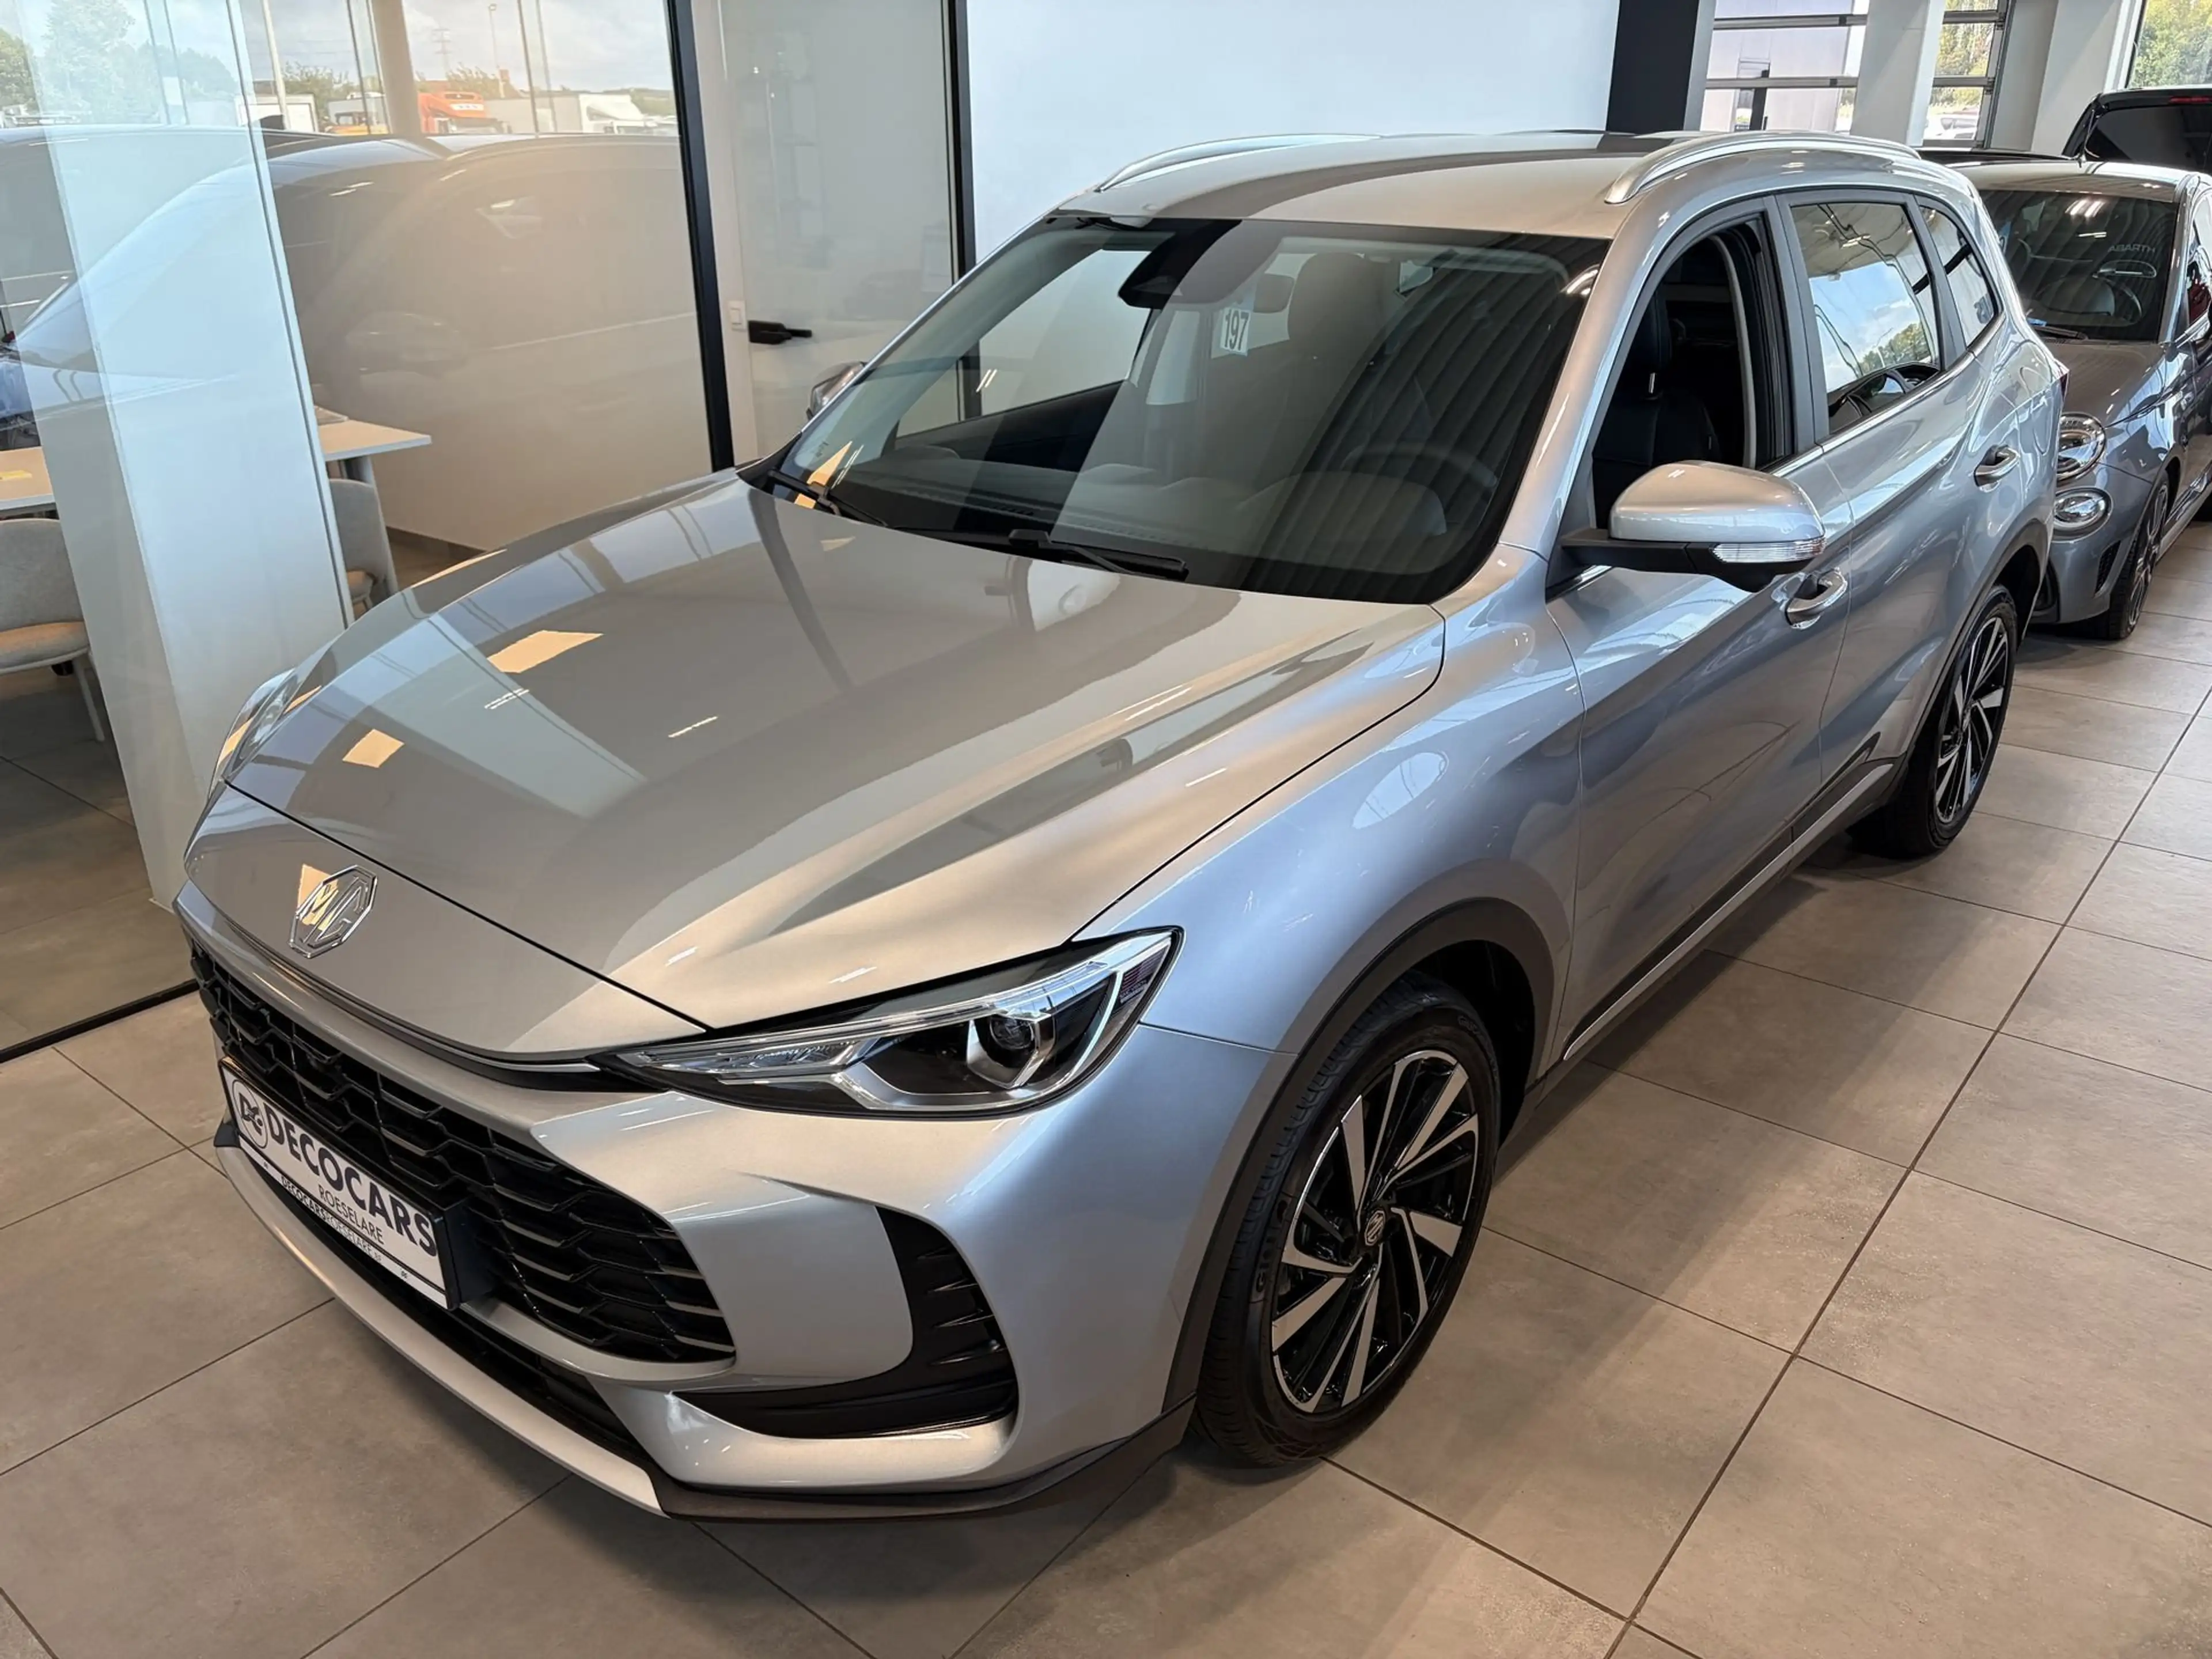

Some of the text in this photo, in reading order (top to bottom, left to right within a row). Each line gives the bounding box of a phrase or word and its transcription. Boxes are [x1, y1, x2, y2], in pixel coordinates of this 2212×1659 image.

[2107, 243, 2156, 253] ABARTH
[1224, 308, 1250, 351] 197
[263, 1101, 437, 1257] DECOCARS
[318, 1184, 385, 1245] ROESELARE
